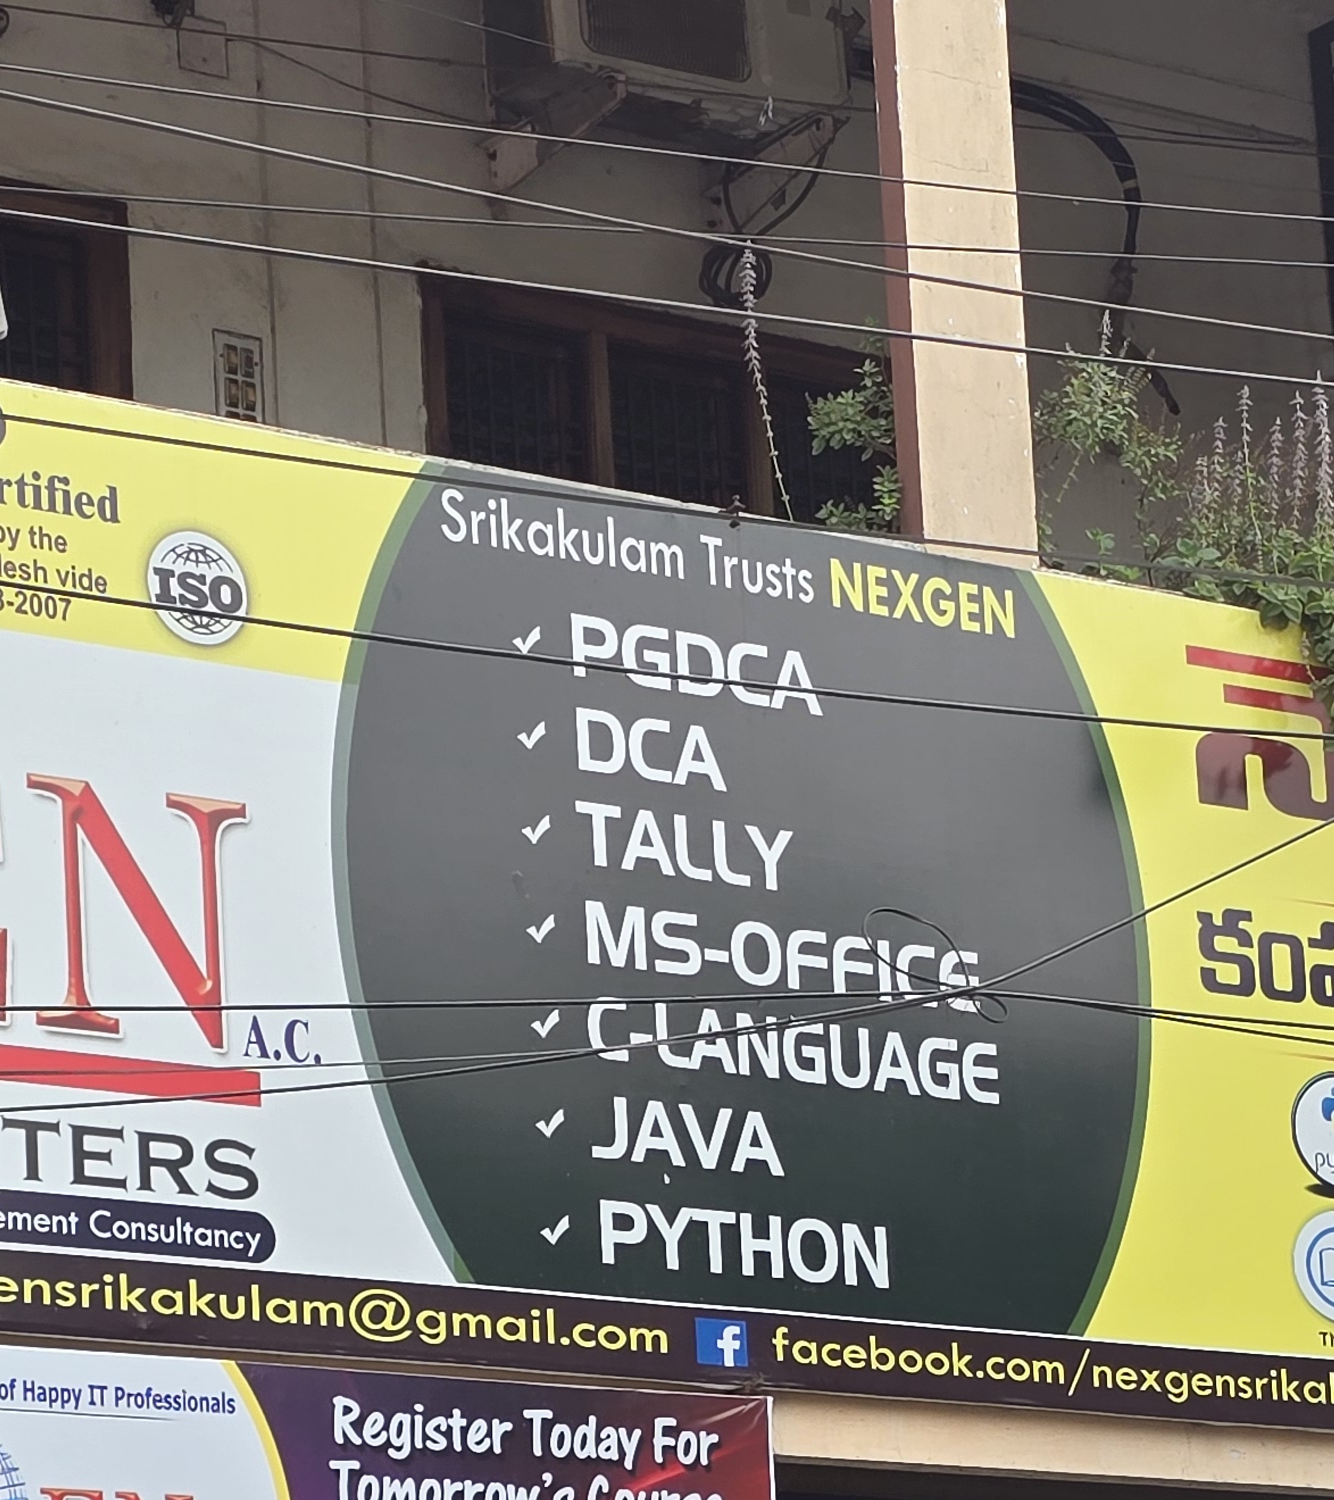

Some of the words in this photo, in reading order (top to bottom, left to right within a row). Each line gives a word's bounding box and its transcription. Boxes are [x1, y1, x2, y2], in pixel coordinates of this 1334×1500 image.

[57, 564, 108, 594] vide
[154, 567, 243, 614] ISO
[441, 491, 685, 581] Srikakulam
[700, 536, 814, 603] Trusts
[830, 558, 1016, 639] NEXGEN
[570, 614, 823, 716] PGDCA
[576, 707, 727, 792] DCA
[575, 802, 793, 890] TALLY
[586, 901, 980, 1014] MS-OFFICE
[243, 1015, 322, 1066] A.C.
[589, 998, 1001, 1105] C-LANGUAGE
[591, 1098, 784, 1177] JAVA
[600, 1201, 890, 1289] PYTHON
[22, 1379, 82, 1410] Happy
[88, 1384, 108, 1407] IT
[115, 1387, 236, 1415] Professionals
[332, 1397, 513, 1460] Register
[524, 1409, 641, 1470] Today
[653, 1418, 719, 1466] For
